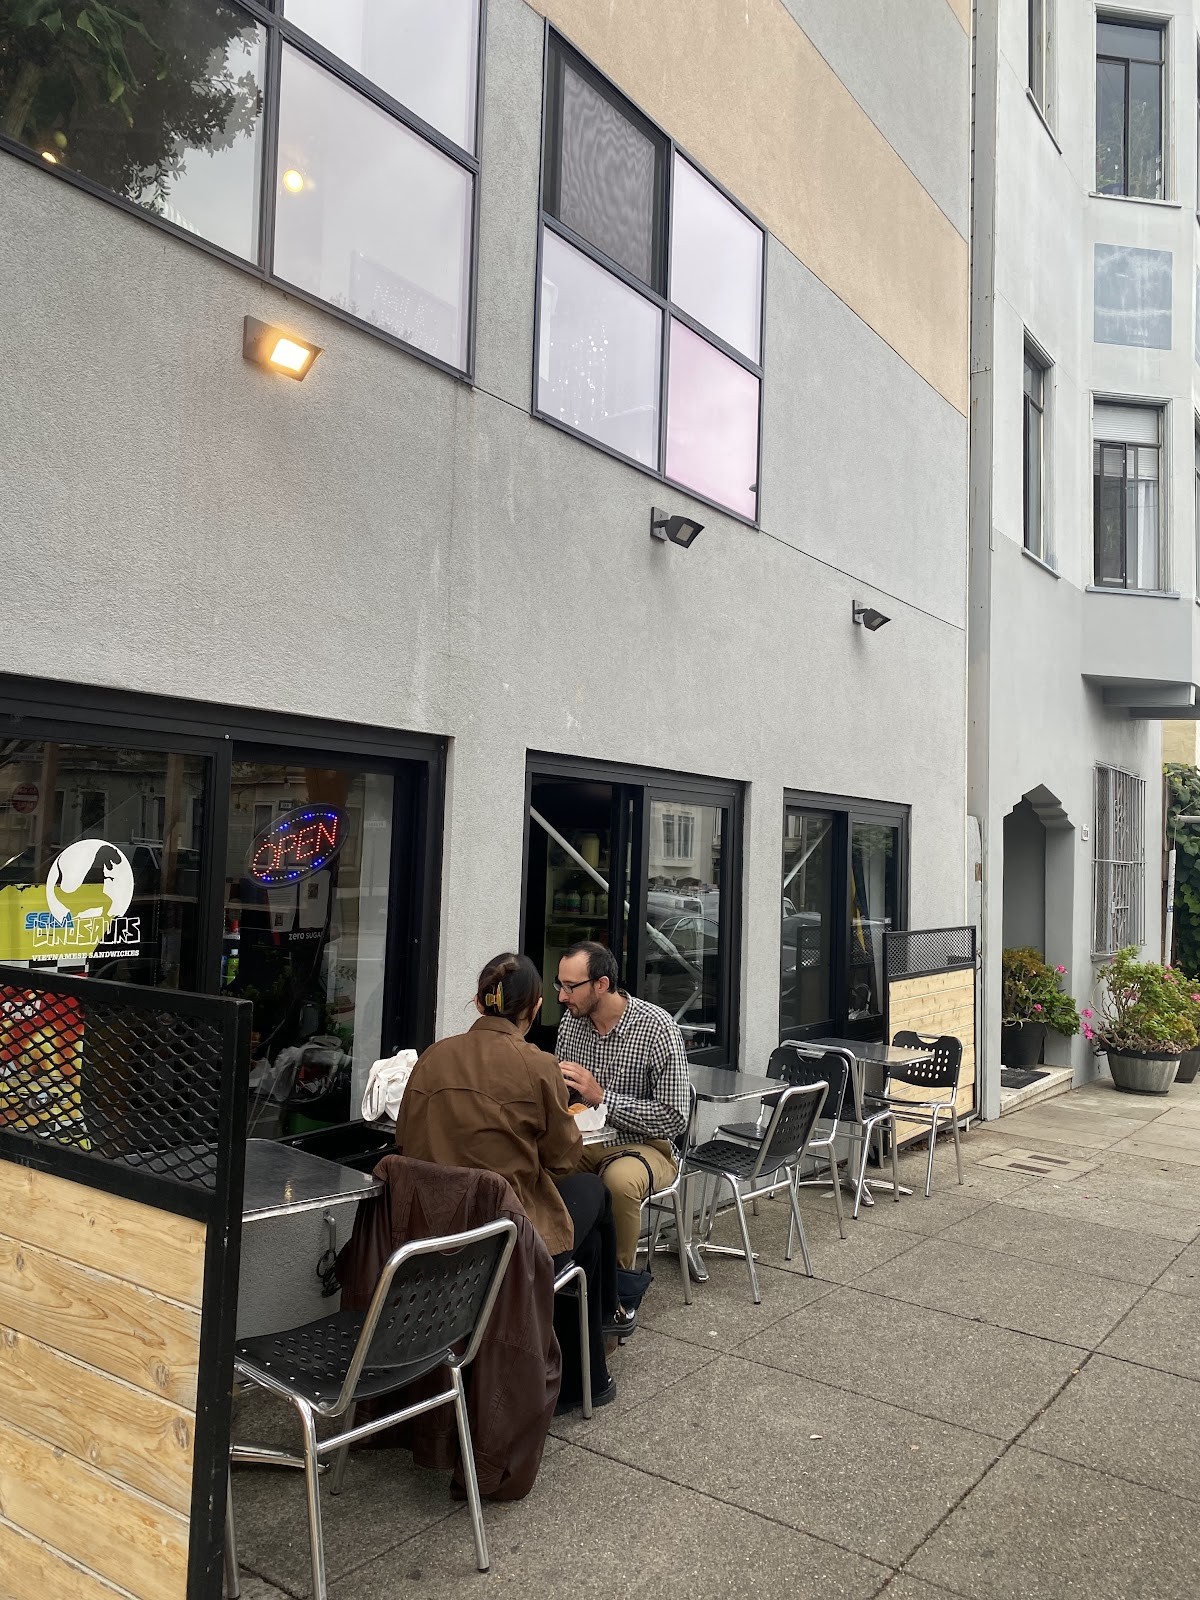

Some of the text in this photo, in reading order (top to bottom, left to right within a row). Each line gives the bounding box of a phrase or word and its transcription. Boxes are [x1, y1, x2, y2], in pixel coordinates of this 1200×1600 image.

[252, 815, 338, 877] OPEN
[33, 917, 140, 947] DINOSAURS
[288, 931, 325, 940] zero SUGA
[32, 950, 140, 961] VIETNAMESE SANDWICHES
